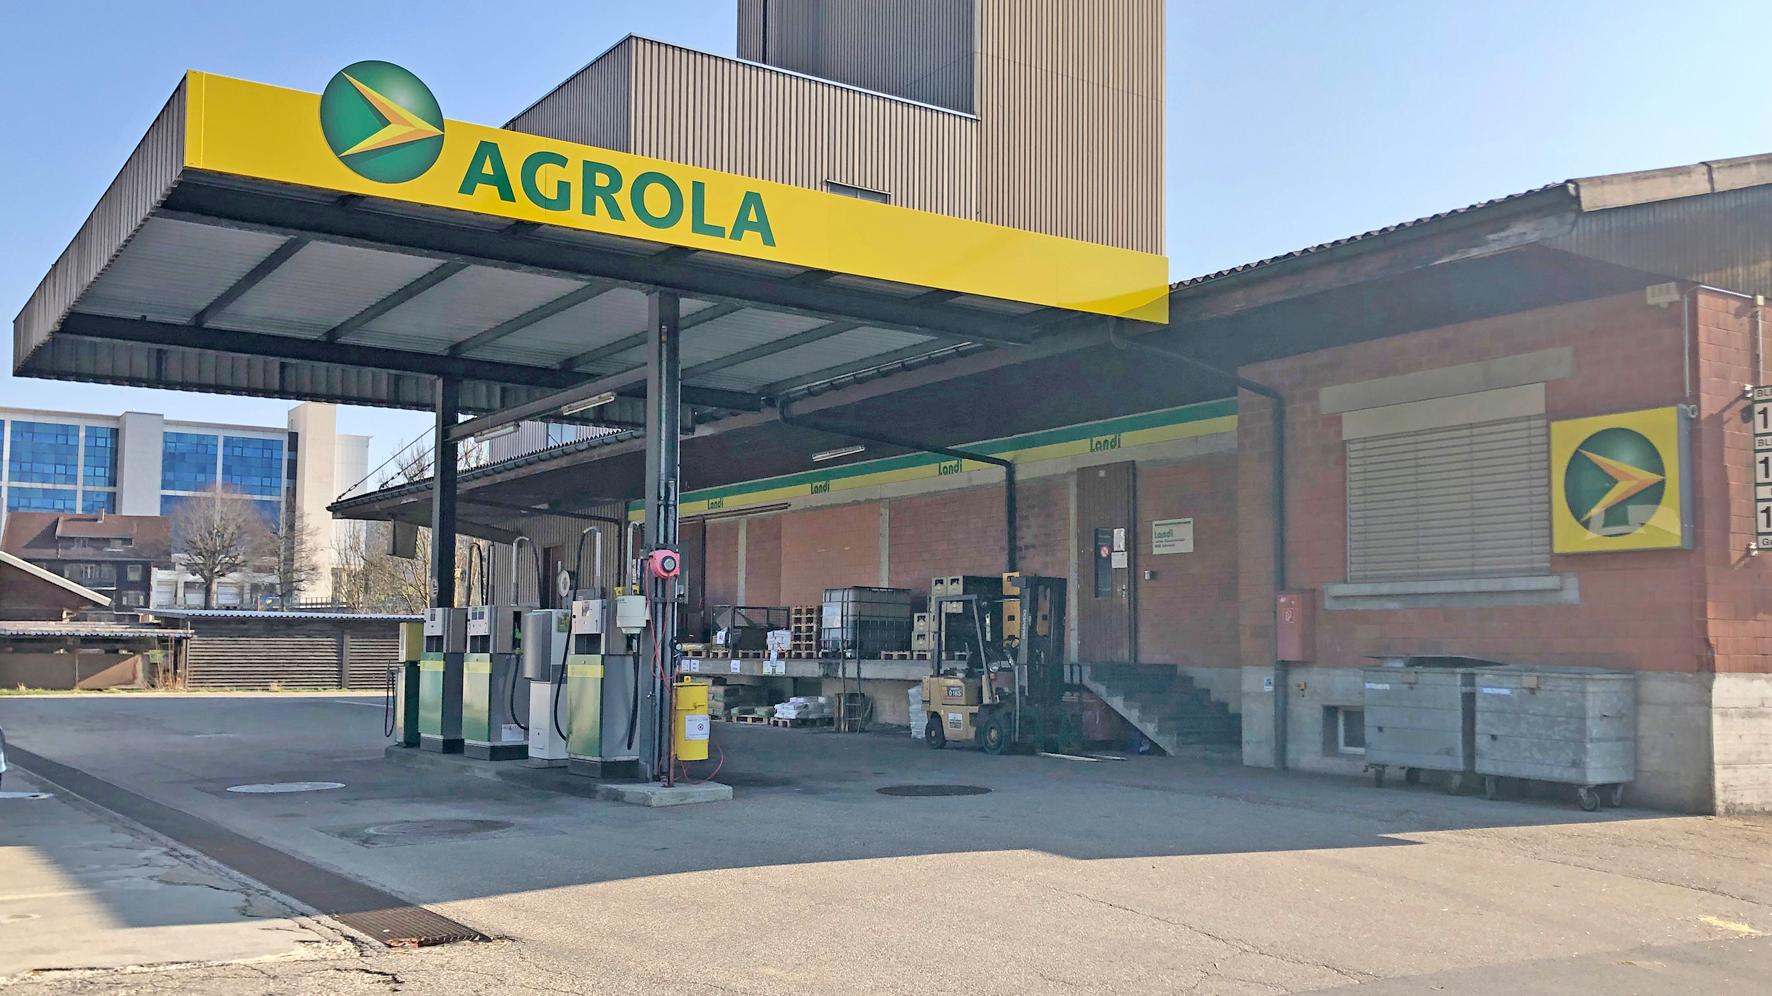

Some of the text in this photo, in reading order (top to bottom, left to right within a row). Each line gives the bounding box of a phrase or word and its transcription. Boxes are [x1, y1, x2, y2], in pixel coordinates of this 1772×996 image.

[458, 140, 777, 248] AGROLA
[1757, 388, 1772, 398] BL
[1089, 433, 1121, 453] Landi
[1757, 438, 1772, 447] BL
[938, 459, 963, 476] Landi
[810, 480, 830, 495] Landi
